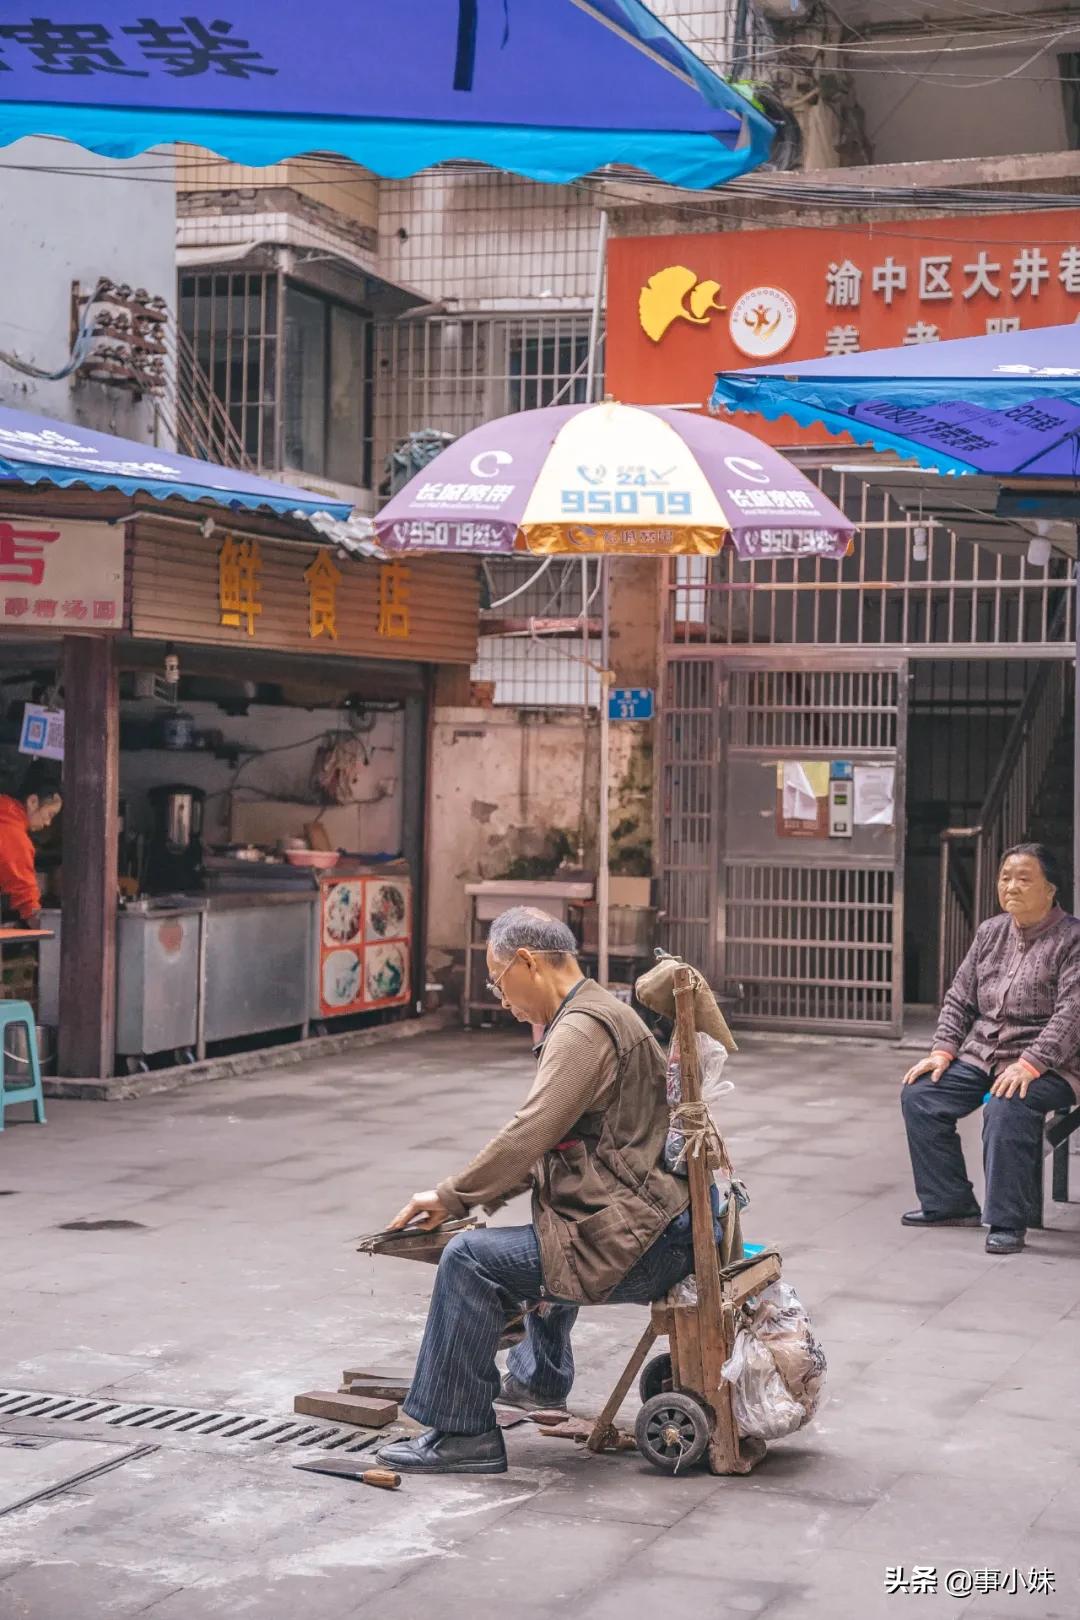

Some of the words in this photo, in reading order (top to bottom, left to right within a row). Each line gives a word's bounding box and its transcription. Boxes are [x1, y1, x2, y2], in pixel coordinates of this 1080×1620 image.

[825, 246, 1080, 307] 渝中区大井巷
[415, 482, 516, 503] 长城宽带
[560, 489, 693, 514] 95079
[409, 521, 474, 546] 95079
[760, 528, 815, 553] 95079
[219, 533, 413, 640] 鲜食店
